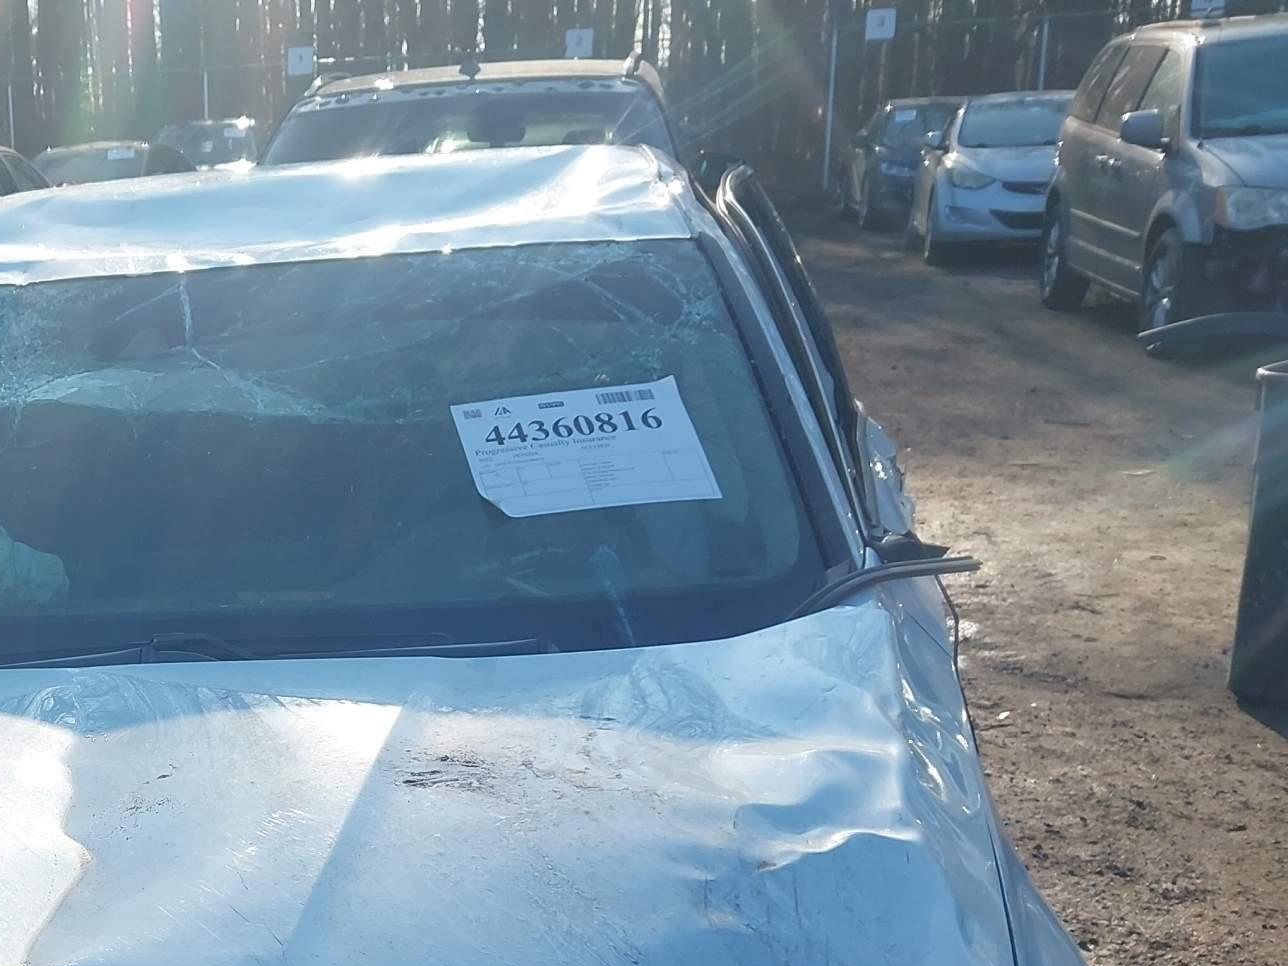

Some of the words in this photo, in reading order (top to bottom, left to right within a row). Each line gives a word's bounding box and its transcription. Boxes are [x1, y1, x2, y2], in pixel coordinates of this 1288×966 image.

[485, 407, 663, 446] 44360816
[475, 445, 527, 457] Progressive
[530, 439, 570, 450] Casualty
[573, 435, 616, 445] Insurance
